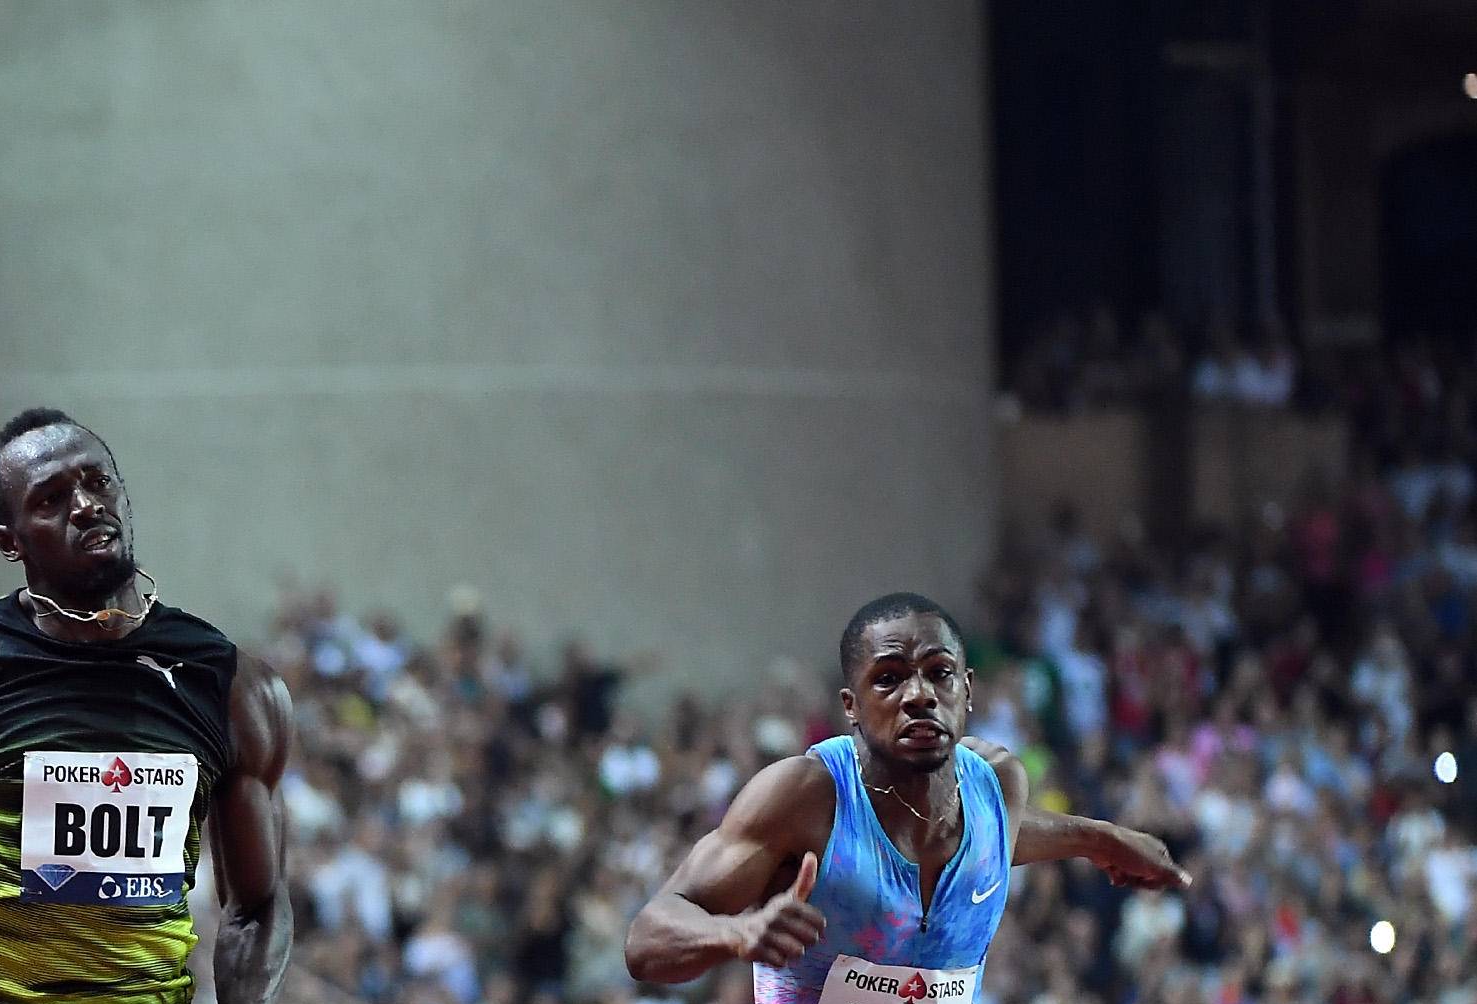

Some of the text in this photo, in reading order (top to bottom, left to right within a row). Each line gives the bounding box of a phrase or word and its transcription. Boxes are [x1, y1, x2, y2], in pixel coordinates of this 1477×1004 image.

[43, 764, 184, 786] POKER STARS
[53, 802, 173, 858] BOLT
[125, 877, 165, 898] EBS
[844, 969, 965, 999] POKER STARS
